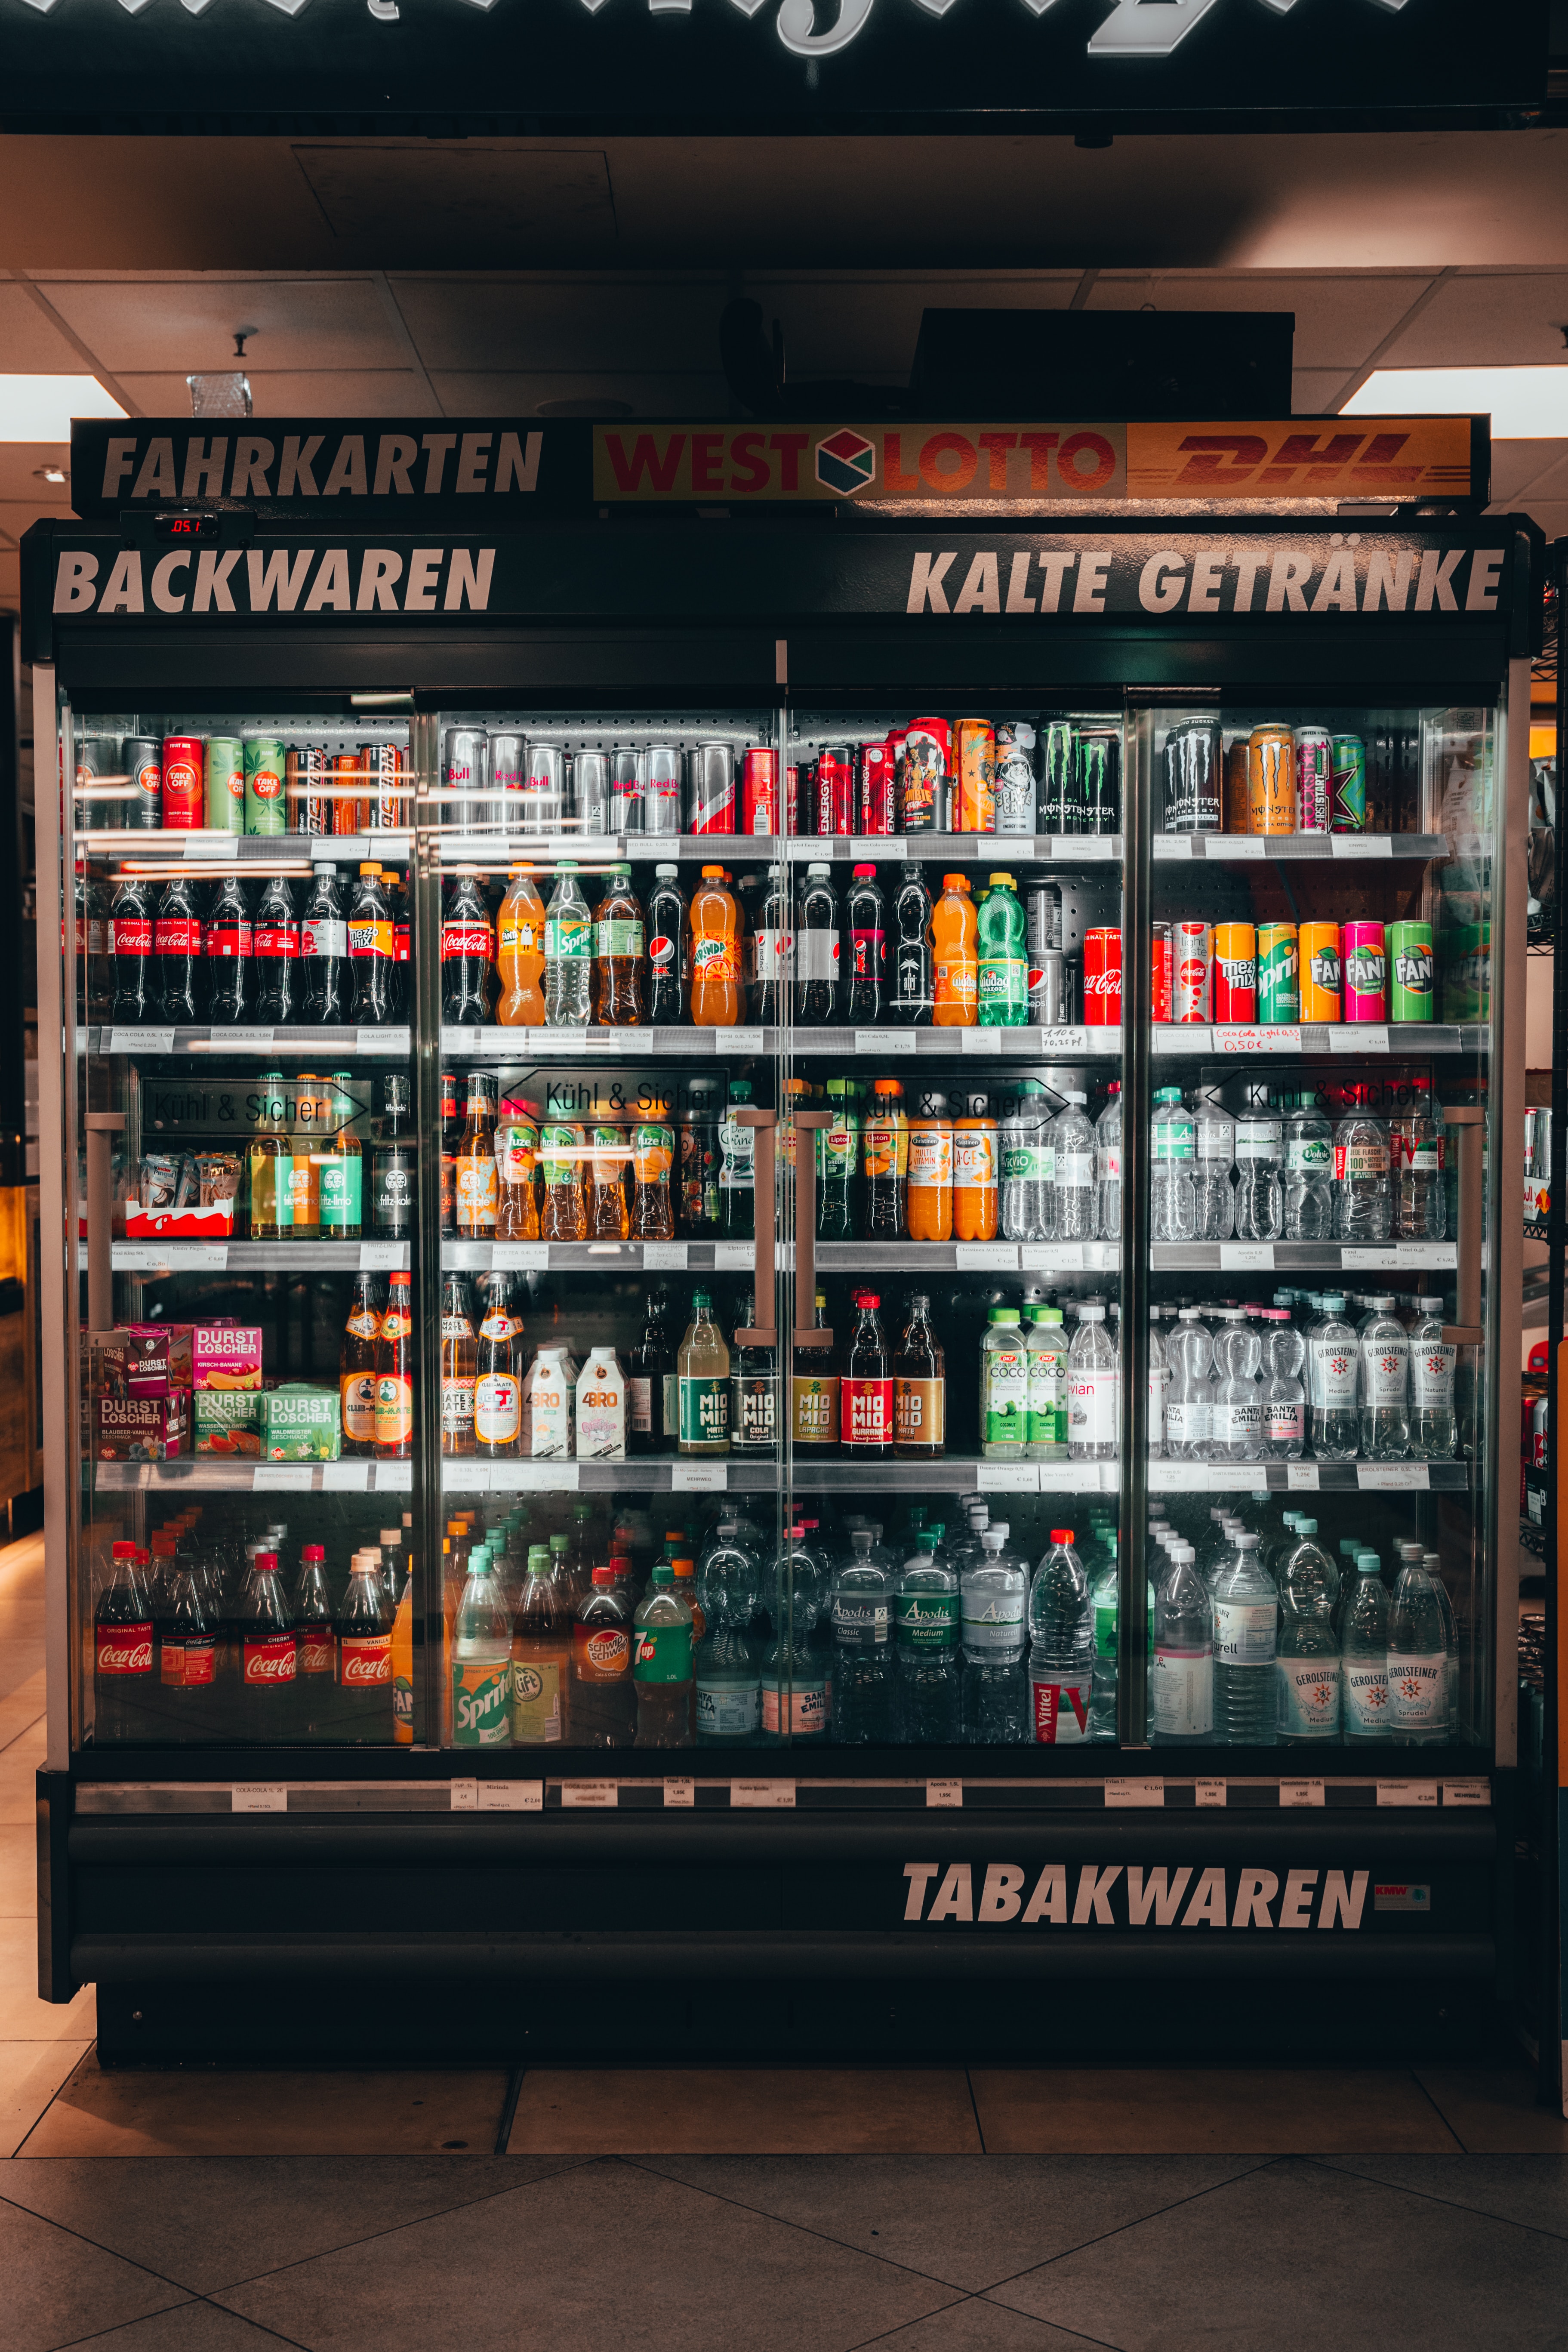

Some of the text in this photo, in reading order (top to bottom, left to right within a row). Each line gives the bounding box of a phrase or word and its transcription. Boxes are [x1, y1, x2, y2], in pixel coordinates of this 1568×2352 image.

[102, 432, 543, 498] FAHRKARTEN
[604, 431, 1116, 492] WEST LOTTO
[1173, 433, 1426, 485] DHL
[906, 532, 1505, 613] KALTE GETRÄNKE
[52, 549, 496, 613] BACKWAREN
[530, 776, 548, 787] Bull
[613, 780, 631, 790] Red
[1302, 744, 1315, 829] ROCKSTAR
[995, 790, 1031, 805] SPACE
[1003, 801, 1025, 814] CAT
[117, 933, 152, 947] Coca-Cola
[155, 933, 189, 946] Coca-Cola
[350, 926, 379, 941] mezzo
[352, 937, 372, 949] mix
[446, 934, 486, 951] Coca-Cola
[1181, 937, 1204, 946] light
[694, 941, 726, 964] MIRINDA
[1180, 949, 1207, 957] taste
[904, 973, 916, 988] afri
[547, 1082, 714, 1110] Kühl & Sicher
[1251, 1079, 1420, 1108] Kühl & Sicher
[156, 1093, 322, 1122] Kühl & Sicher
[858, 1090, 1025, 1119] Kühl & Sicher
[1305, 1146, 1329, 1159] Volvic
[198, 1331, 257, 1344] DURST
[198, 1341, 256, 1354] LÖSCHER
[1318, 1347, 1357, 1358] GEROLSTEINER
[1368, 1347, 1408, 1357] GEROLSTEINER
[1414, 1347, 1454, 1357] GEROLSTEINER
[990, 1367, 1026, 1378] COCO
[1030, 1367, 1065, 1378] COCO
[102, 1400, 160, 1413] DURST
[198, 1395, 257, 1408] DURST
[271, 1399, 331, 1413] DURST
[582, 1393, 617, 1407] 4BRO
[700, 1394, 727, 1409] MIO
[743, 1394, 774, 1410] MIO
[852, 1396, 884, 1411] MIO
[102, 1410, 160, 1424] LÖSCHER
[198, 1405, 256, 1418] LÖSCHER
[271, 1410, 331, 1423] LÖSCHER
[1264, 1413, 1297, 1421] EMILIA
[1266, 1406, 1296, 1414] SANTA
[700, 1410, 727, 1426] MIO
[744, 1410, 774, 1426] MIO
[852, 1412, 884, 1427] MIO
[832, 1598, 871, 1618] Apodis
[905, 1600, 949, 1622] Apodis
[982, 1601, 1022, 1622] Apodis
[838, 1627, 859, 1636] Classic
[990, 1628, 1017, 1637] Naturell
[1389, 1667, 1437, 1679] GEROLSTEINER
[1038, 1689, 1052, 1728] Vittel
[903, 1863, 1370, 1929] TABAKWAREN
